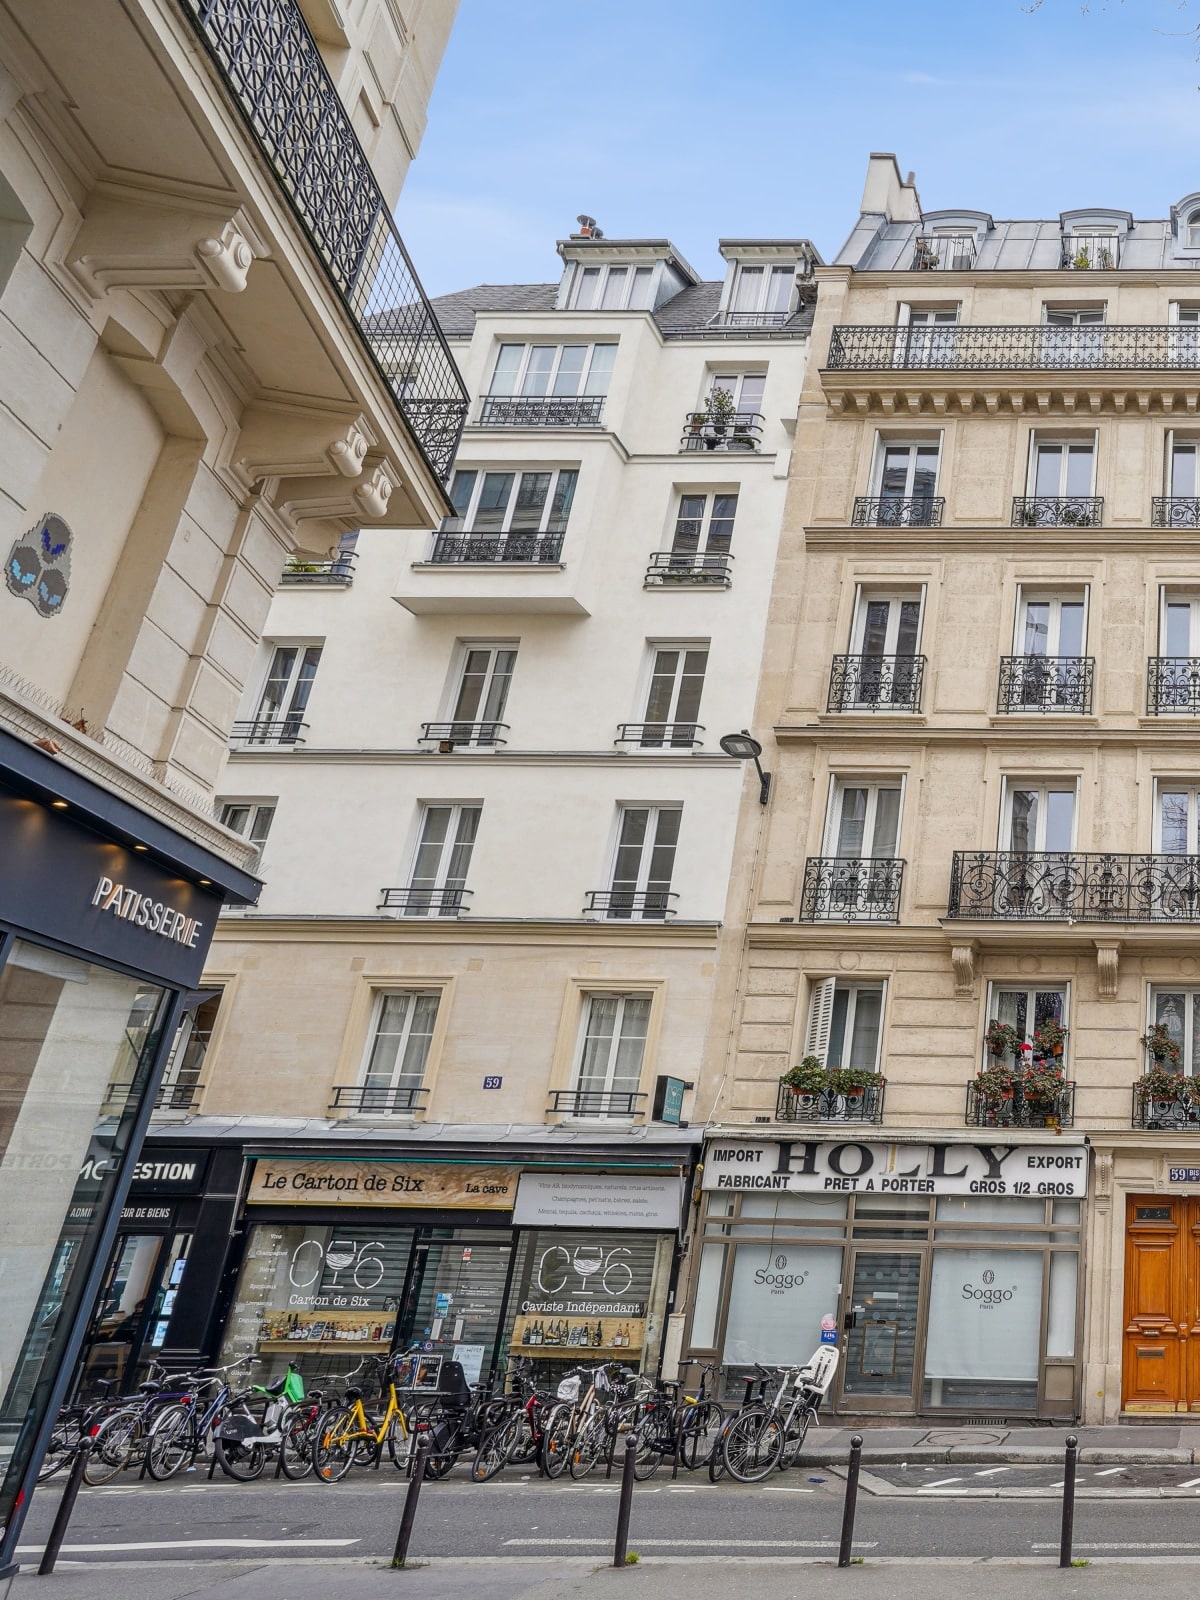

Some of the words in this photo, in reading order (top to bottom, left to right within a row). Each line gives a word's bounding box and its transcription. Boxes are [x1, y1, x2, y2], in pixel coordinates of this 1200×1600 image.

[91, 876, 203, 948] PATISSERIE
[486, 1077, 500, 1088] 59
[713, 1149, 763, 1162] IMPORT
[772, 1141, 1020, 1179] HOLLY
[1027, 1156, 1083, 1169] EXPORT
[1171, 1169, 1186, 1180] 59
[262, 1173, 287, 1189] Le
[292, 1173, 358, 1191] Carton
[364, 1175, 387, 1191] de
[392, 1176, 424, 1192] Six
[465, 1183, 480, 1193] La
[482, 1185, 508, 1194] cave
[717, 1175, 790, 1189] FABRICANT
[824, 1177, 860, 1190] PRET
[866, 1178, 875, 1191] A
[881, 1179, 935, 1193] PORTER
[970, 1180, 1006, 1194] GROS
[1013, 1182, 1030, 1194] 1/2
[1037, 1182, 1074, 1195] GROS
[135, 1208, 147, 1218] DE
[147, 1208, 171, 1218] BIENS
[289, 1294, 331, 1306] Carton
[333, 1295, 347, 1306] de
[350, 1296, 369, 1307] Six
[521, 1300, 564, 1312] Caviste
[566, 1301, 641, 1314] Indépendant
